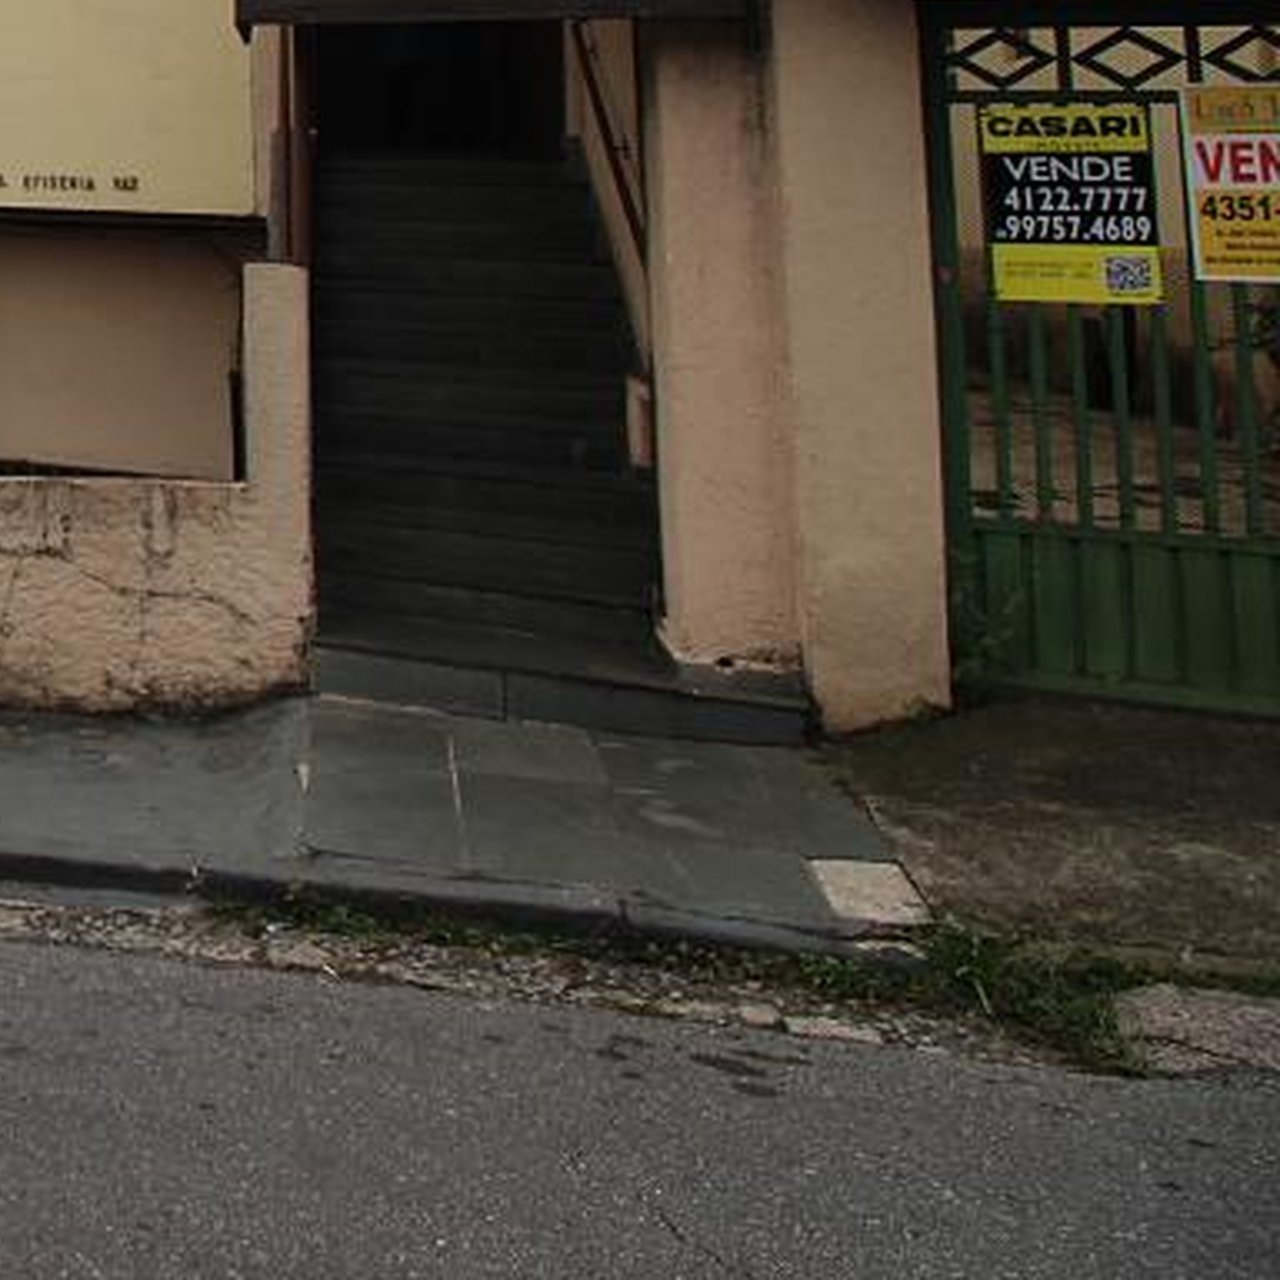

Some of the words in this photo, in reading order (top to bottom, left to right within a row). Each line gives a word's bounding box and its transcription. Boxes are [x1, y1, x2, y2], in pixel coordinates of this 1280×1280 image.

[987, 115, 1141, 137] CASARI
[1003, 156, 1134, 182] VENDE
[1003, 187, 1148, 212] 4122.7777
[1005, 216, 1153, 241] 99757.4689
